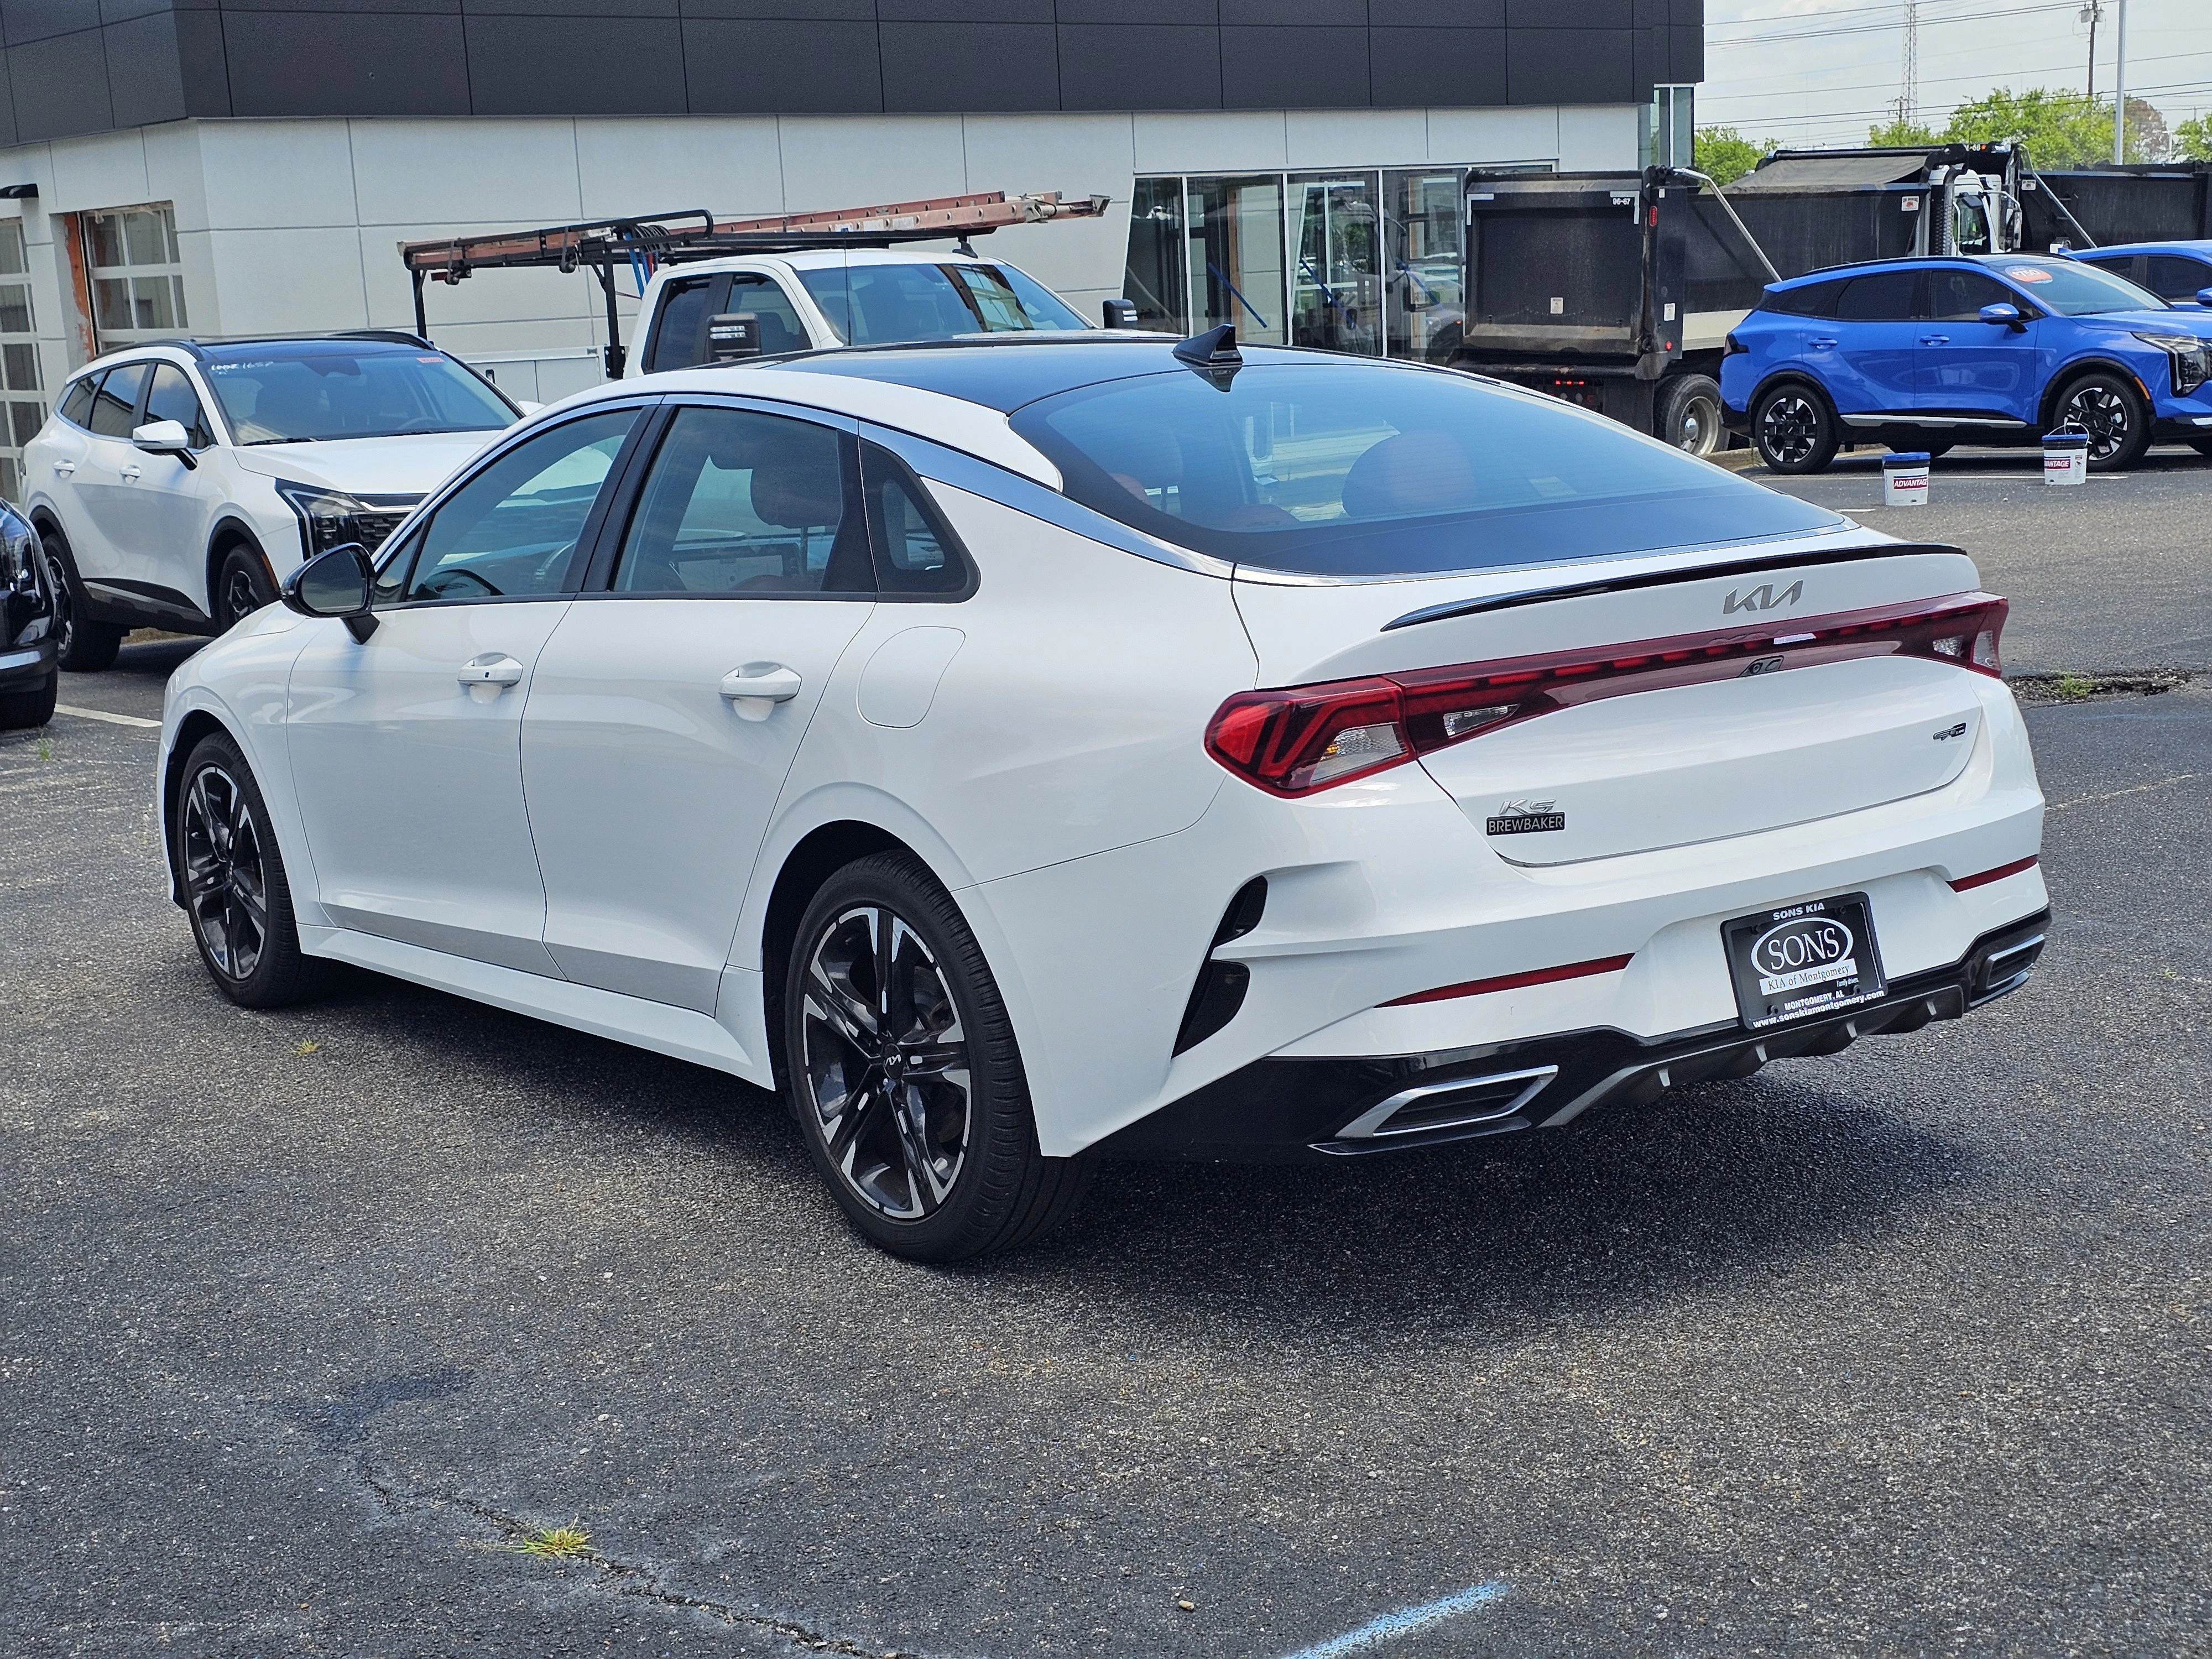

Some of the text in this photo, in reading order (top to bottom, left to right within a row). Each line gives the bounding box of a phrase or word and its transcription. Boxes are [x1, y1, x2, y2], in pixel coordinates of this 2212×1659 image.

[1723, 580, 1803, 614] KIA
[1499, 799, 1557, 815] K5
[1488, 816, 1563, 833] BREWBAKER
[1772, 902, 1825, 921] SONS KIA
[1768, 927, 1839, 971] SONS
[1768, 978, 1786, 991] KIA
[1788, 974, 1797, 986] of
[1798, 965, 1849, 983] Montgomery
[1836, 989, 1845, 999] AL
[1752, 989, 1885, 1029] www.sonskiamontgomery.com
